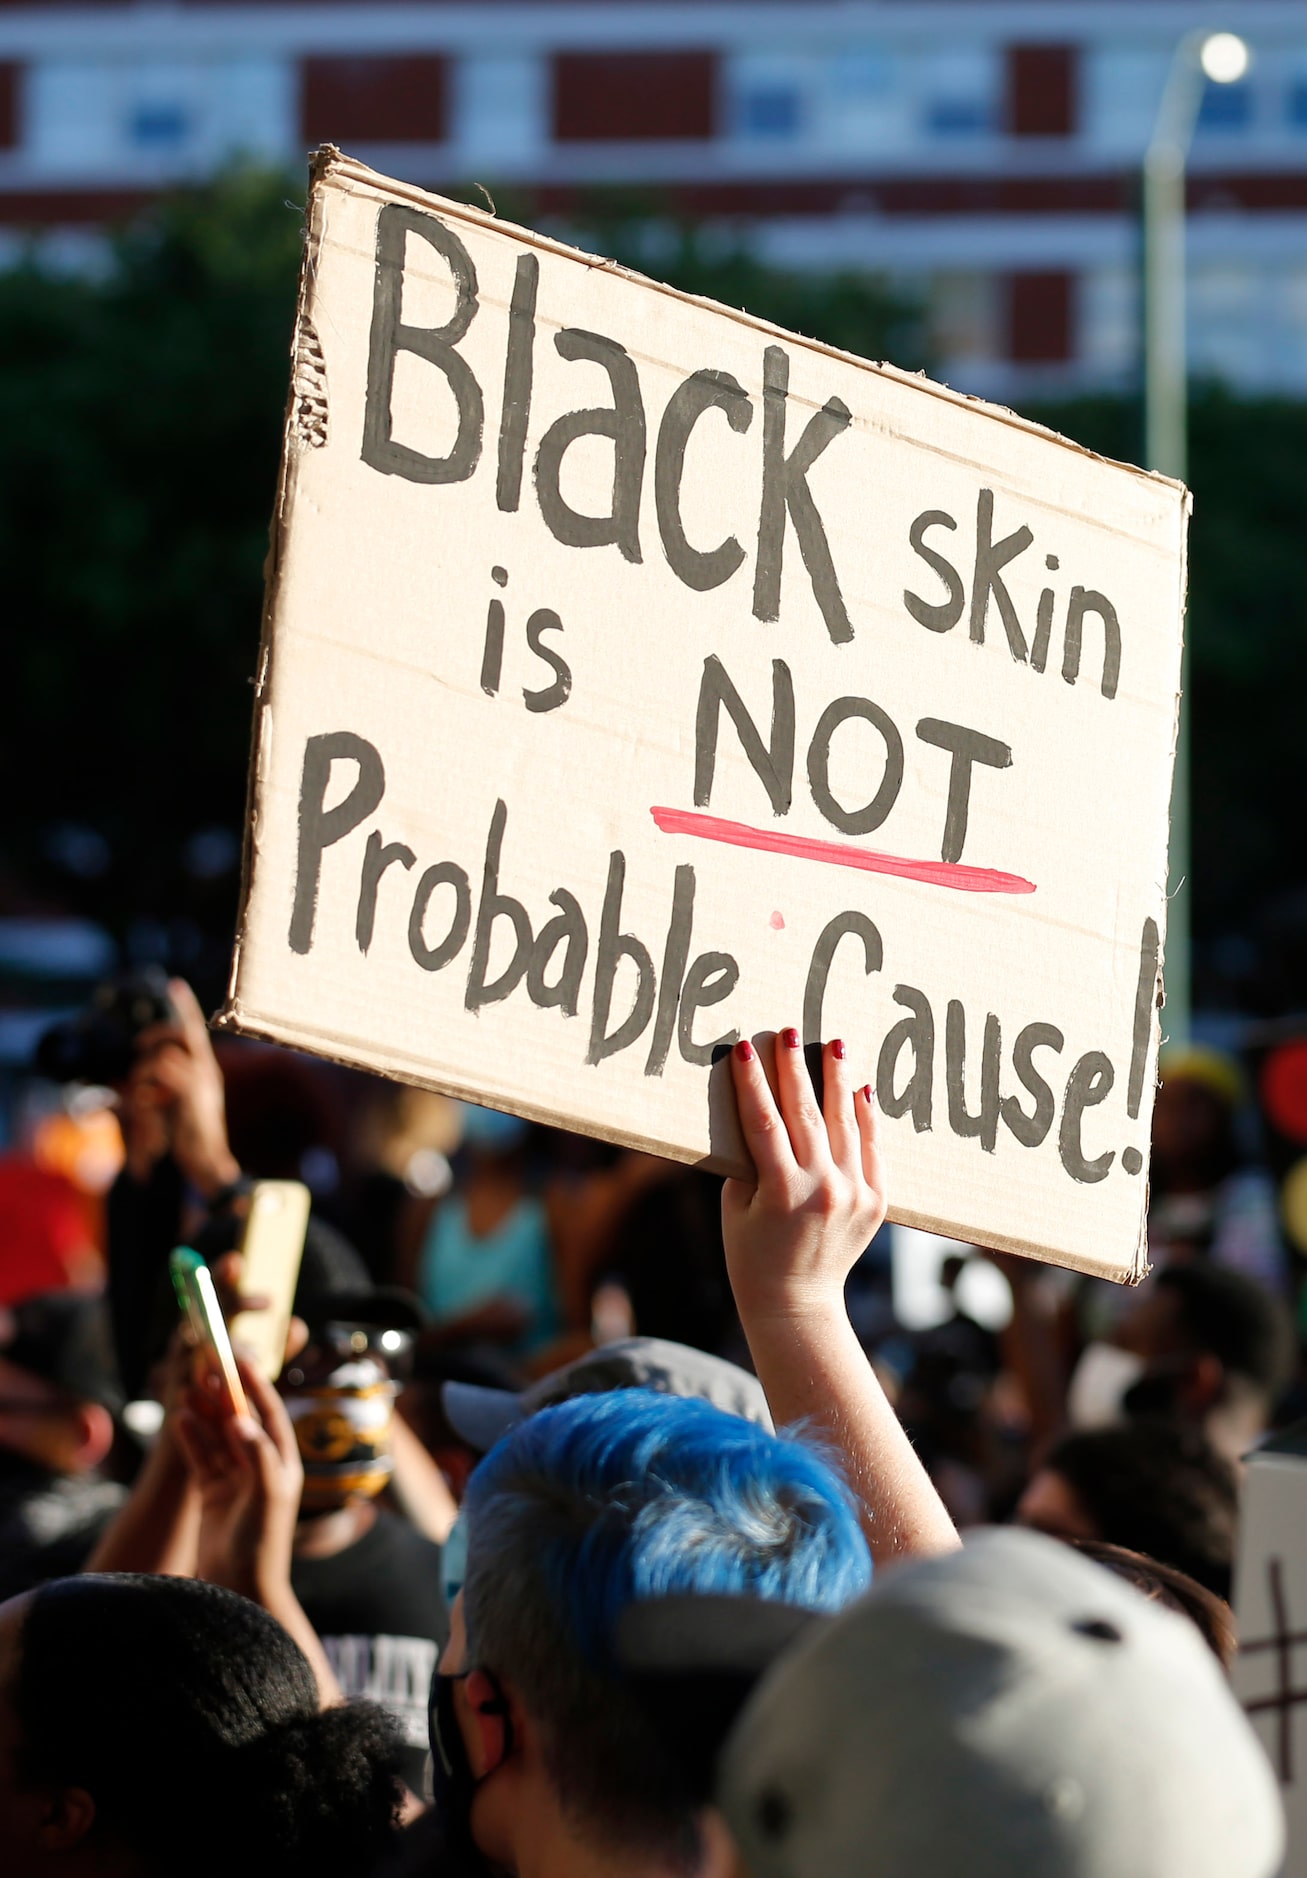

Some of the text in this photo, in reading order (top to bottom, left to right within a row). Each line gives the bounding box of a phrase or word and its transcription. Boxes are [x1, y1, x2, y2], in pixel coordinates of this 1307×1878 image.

[362, 203, 1121, 699] Black skin
[480, 565, 1013, 863] is NOT
[288, 731, 1159, 1183] Probable Cause!
